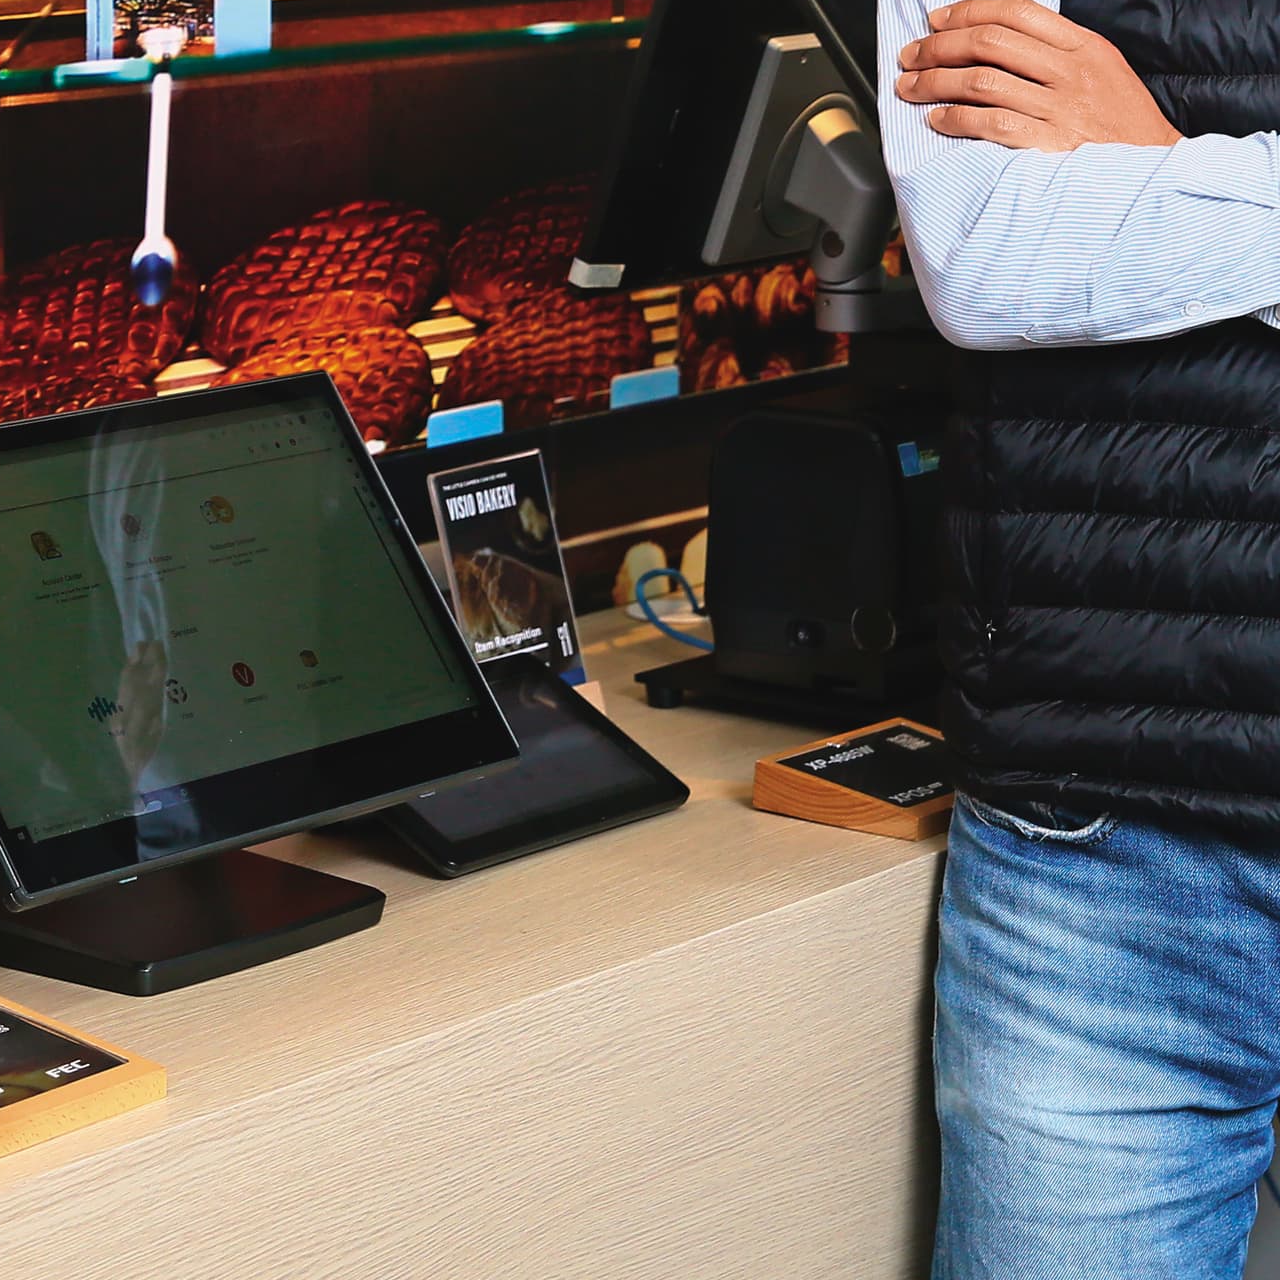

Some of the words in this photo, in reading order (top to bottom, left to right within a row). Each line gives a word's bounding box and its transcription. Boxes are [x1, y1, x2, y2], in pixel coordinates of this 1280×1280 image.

[446, 493, 476, 521] VISIO
[475, 483, 517, 514] BAKERY
[475, 640, 495, 653] Item
[494, 627, 542, 648] Recognition
[45, 1060, 90, 1079] FEC
